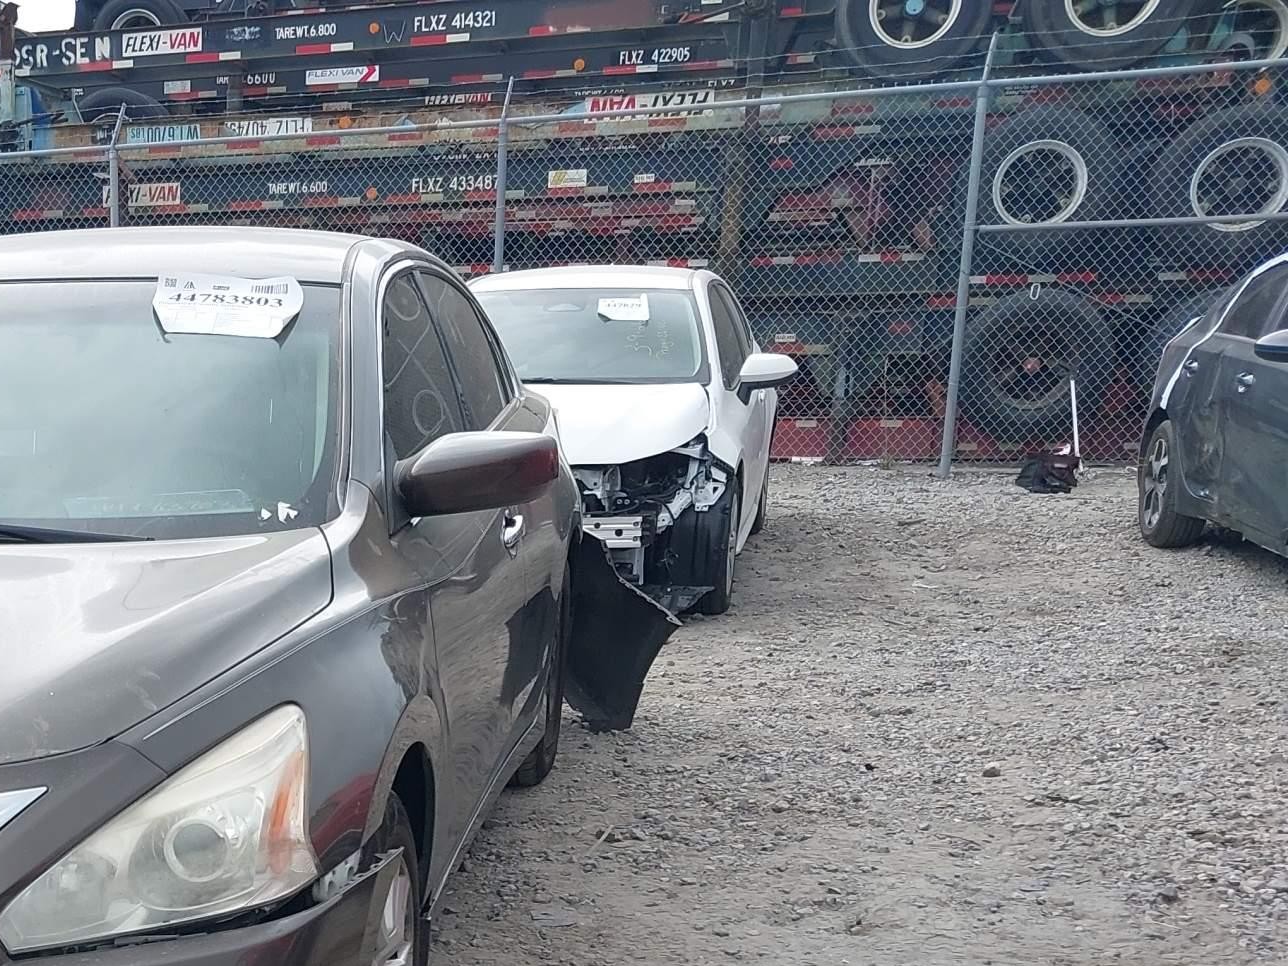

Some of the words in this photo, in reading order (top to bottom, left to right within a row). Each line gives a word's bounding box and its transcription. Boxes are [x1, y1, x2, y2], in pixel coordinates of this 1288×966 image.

[414, 14, 447, 32] FLXZ
[451, 10, 496, 29] 414321
[124, 31, 200, 53] FLEXI-VAN
[619, 49, 643, 65] FLXZ
[652, 47, 690, 63] 422905
[308, 69, 339, 78] FLEXI
[412, 177, 443, 192] FLXZ
[449, 174, 498, 191] 433487
[168, 293, 283, 308] 44783803
